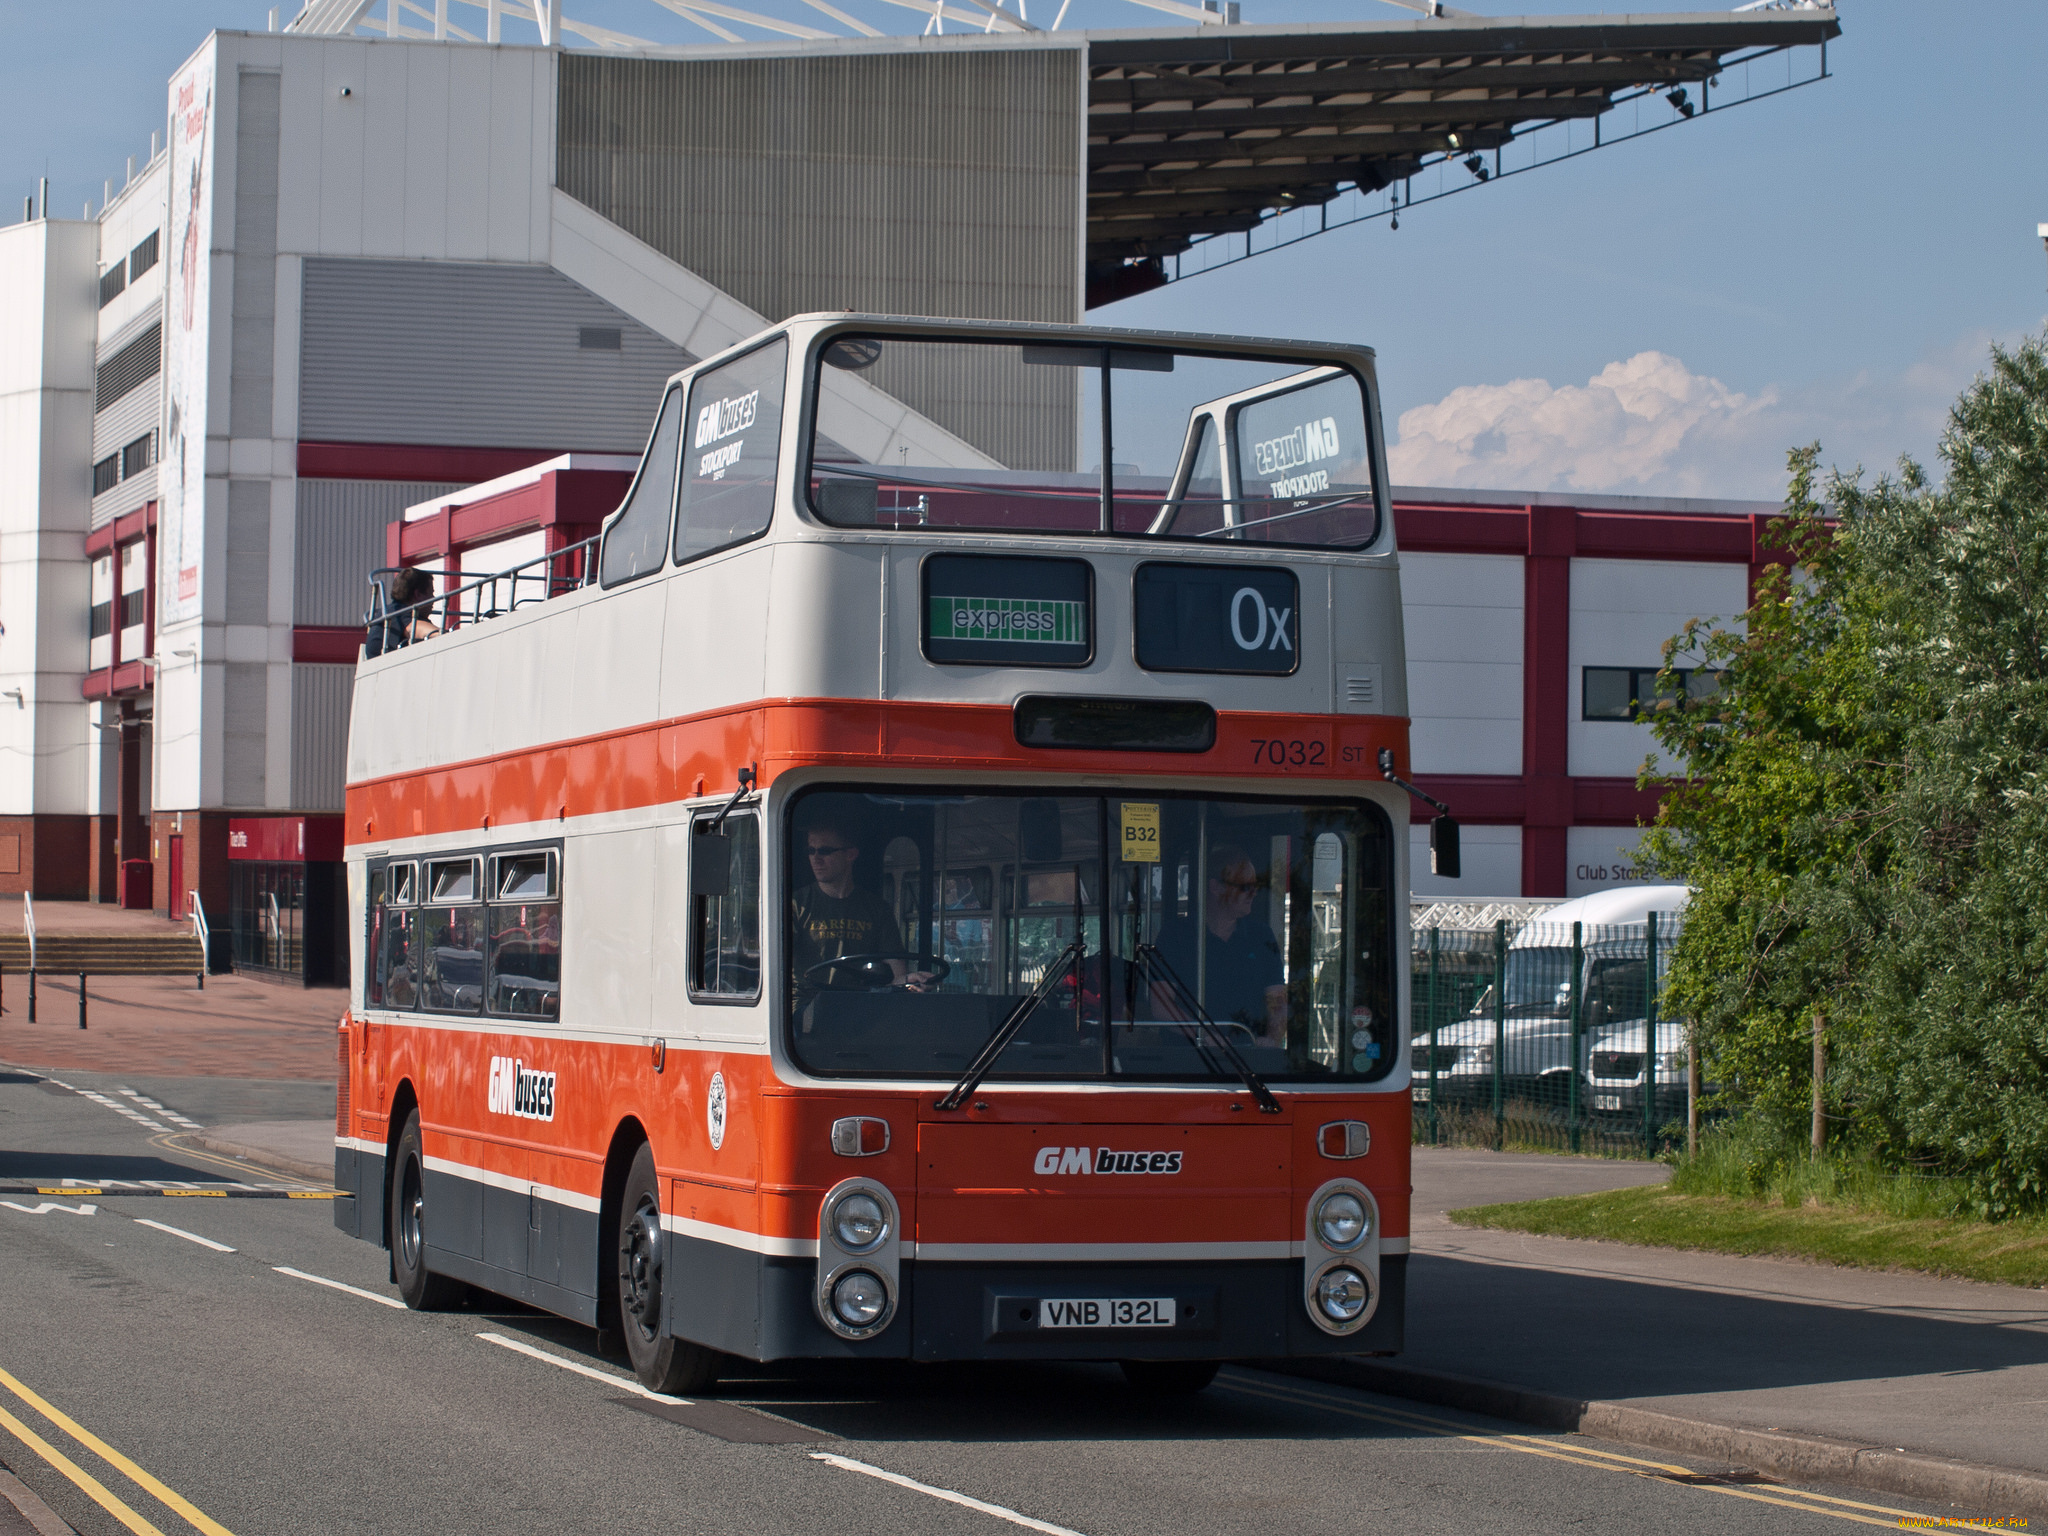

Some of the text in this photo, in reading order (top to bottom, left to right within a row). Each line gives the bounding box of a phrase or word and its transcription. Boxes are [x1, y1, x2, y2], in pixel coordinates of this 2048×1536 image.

[700, 440, 744, 476] STOCKPORT
[953, 607, 1055, 633] express
[1250, 739, 1365, 766] 7032 ST
[1125, 826, 1157, 842] B32
[1576, 864, 1608, 880] Club
[1047, 1300, 1170, 1326] VNB 132L
